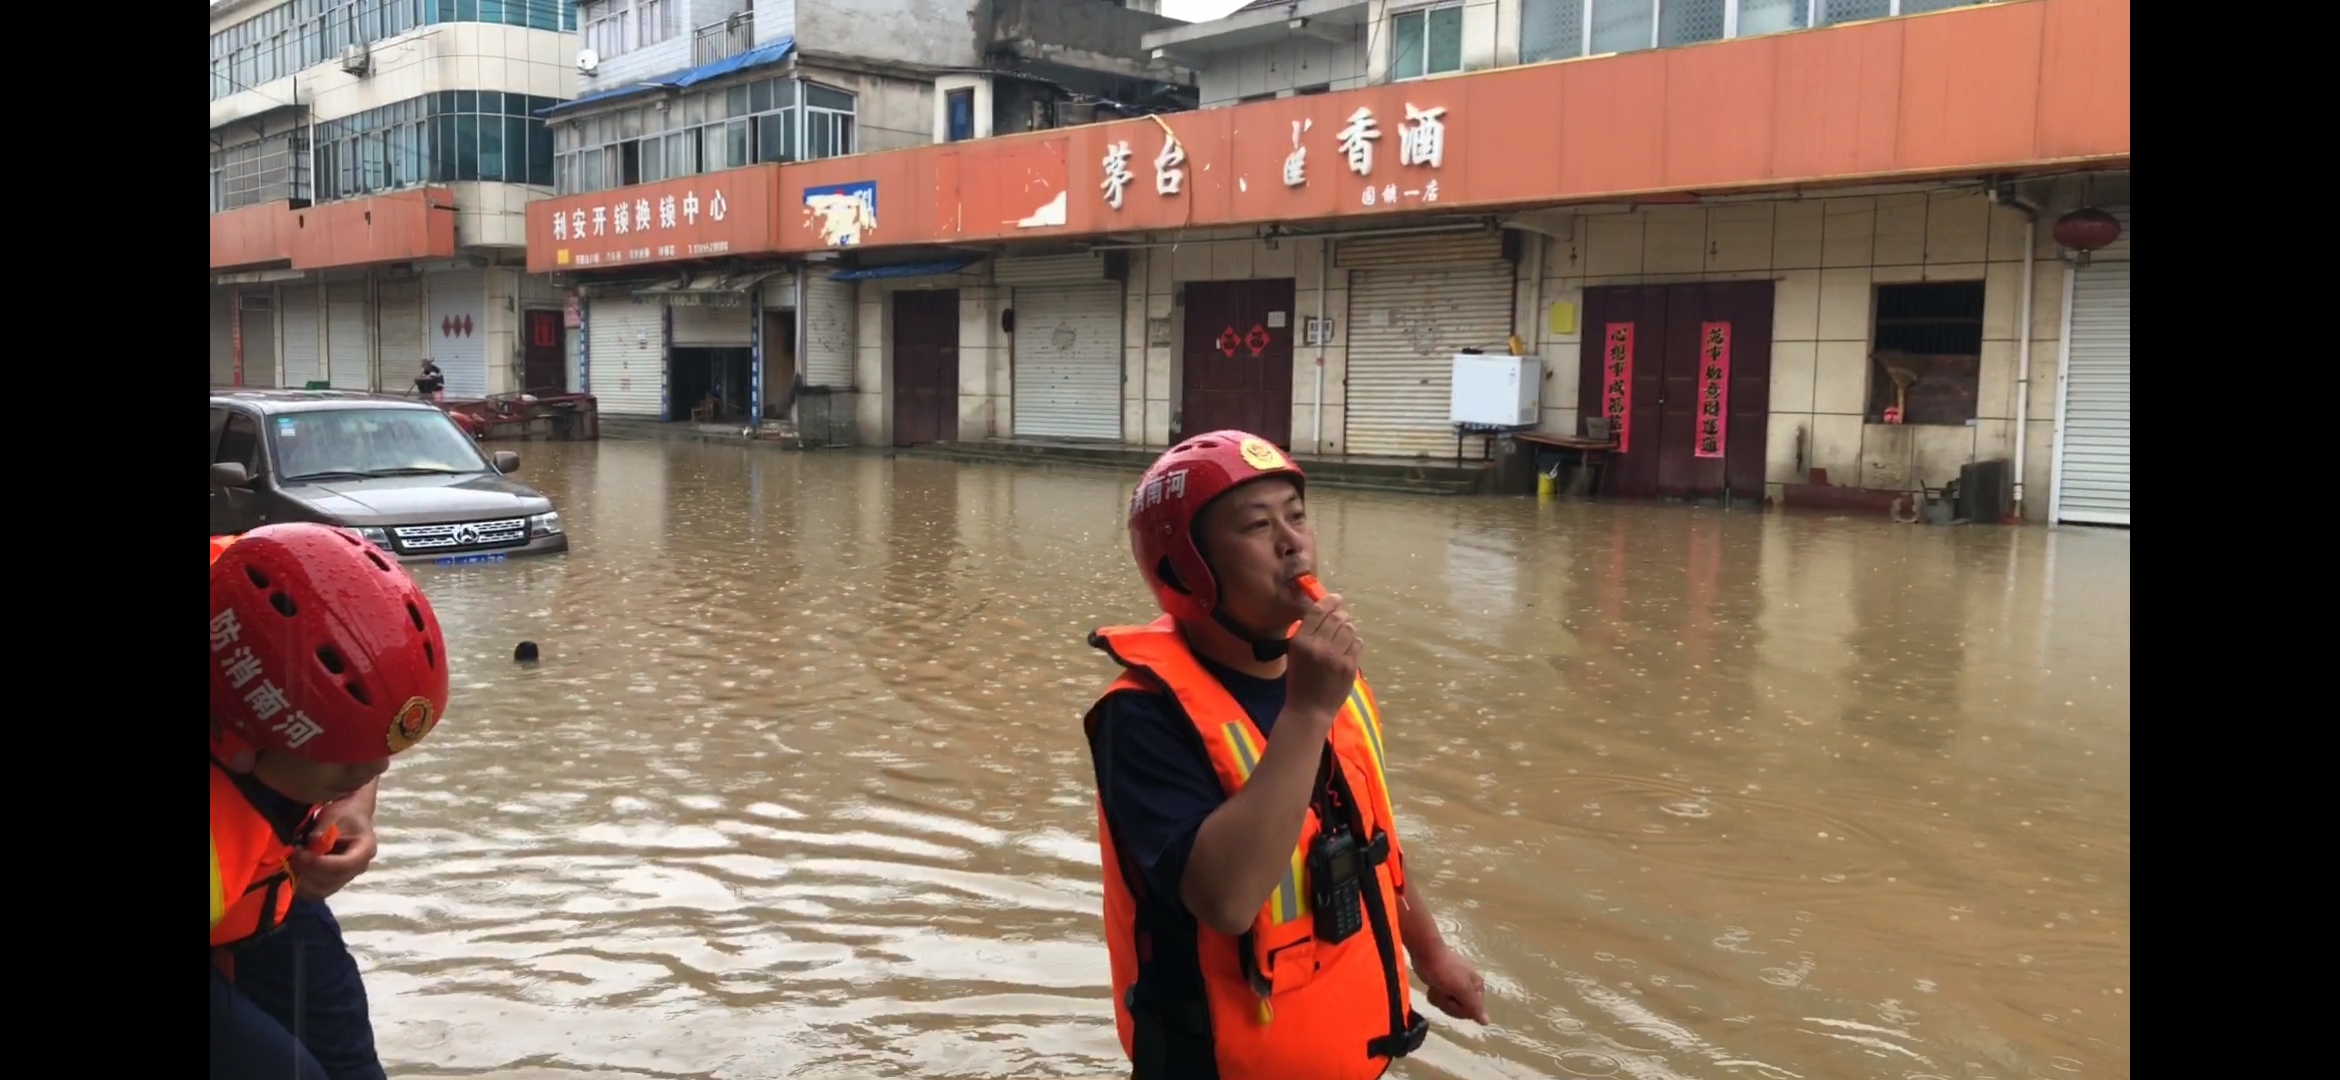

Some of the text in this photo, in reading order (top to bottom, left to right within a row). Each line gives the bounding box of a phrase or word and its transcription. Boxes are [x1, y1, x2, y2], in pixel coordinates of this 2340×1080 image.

[553, 189, 727, 240] 利安开锁换锁中心
